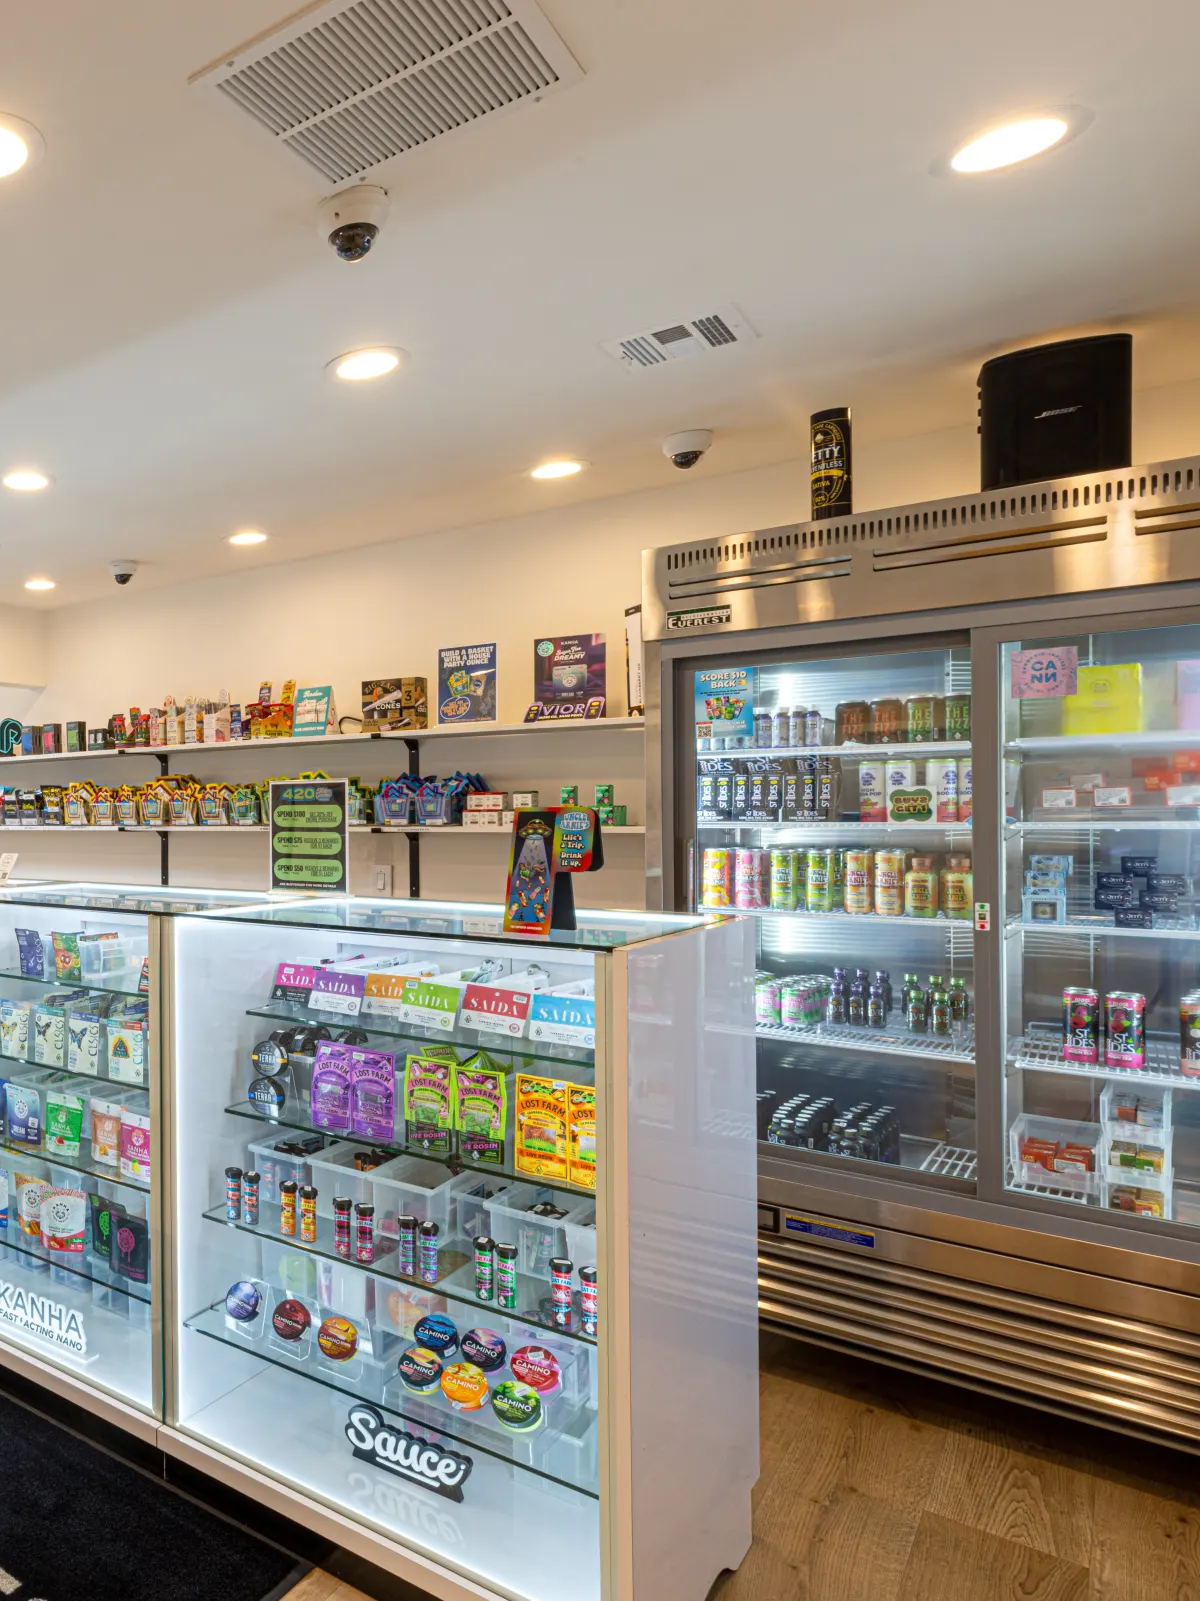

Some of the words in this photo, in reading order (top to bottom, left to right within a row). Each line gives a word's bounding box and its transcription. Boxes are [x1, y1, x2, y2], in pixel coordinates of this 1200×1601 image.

[1034, 405, 1083, 420] BOSE
[812, 444, 841, 462] ETTY
[667, 614, 729, 629] EVEREST
[441, 650, 460, 658] BUILD
[468, 646, 494, 655] BASKET
[444, 655, 460, 663] WITH
[468, 652, 491, 660] HOUSE
[554, 652, 586, 662] DREAMY
[443, 660, 465, 669] PARTY
[466, 658, 489, 666] OUNCE
[1031, 659, 1058, 671] CA
[700, 672, 730, 682] SCORE
[731, 670, 748, 681] $10
[363, 680, 397, 694] ZIG-ZAG
[711, 680, 737, 689] BACK
[404, 690, 413, 702] 3
[375, 701, 401, 711] CONES
[945, 706, 970, 718] THE
[842, 713, 864, 724] THE
[874, 710, 897, 722] THE
[907, 708, 932, 720] THE
[841, 724, 864, 735] FIZZ
[873, 722, 896, 733] FIZZ
[907, 720, 932, 732] FIZZ
[945, 718, 970, 729] FIZZ
[282, 787, 316, 801] 420
[293, 810, 306, 818] $100
[563, 811, 588, 822] UNCLE
[560, 820, 590, 831] ARNIE'S
[567, 841, 585, 850] Trip.
[561, 851, 582, 860] Drink
[569, 860, 582, 868] up.
[317, 980, 357, 995] SAIDA
[371, 984, 404, 998] SAID
[407, 991, 449, 1010] SAIDA
[469, 997, 519, 1017] SAIDA
[538, 1006, 594, 1026] SAIDA
[1075, 1028, 1090, 1039] ST
[1114, 1032, 1128, 1044] ST
[258, 1053, 277, 1063] TERRA
[318, 1061, 333, 1071] LOST
[333, 1061, 351, 1076] FARM
[354, 1069, 371, 1079] LOST
[371, 1070, 392, 1084] FARM
[411, 1078, 427, 1088] LOST
[428, 1079, 449, 1094] FARM
[254, 1091, 272, 1101] TERRA
[461, 1088, 478, 1097] LOST
[479, 1088, 501, 1103] FARM
[520, 1099, 540, 1110] LOST
[541, 1100, 566, 1117] FARM
[572, 1110, 594, 1120] LOST
[423, 1131, 446, 1139] ROSIN
[126, 1143, 149, 1156] KANHA
[473, 1142, 498, 1151] ROSIN
[274, 1313, 293, 1326] CAMINO
[23, 1320, 55, 1340] ACTING
[56, 1333, 84, 1352] NANO
[319, 1333, 341, 1345] CAMINO
[418, 1326, 451, 1342] CAMINO
[465, 1340, 499, 1359] CAMINO
[402, 1360, 436, 1377] CAMINO
[515, 1359, 552, 1377] CAMINO
[445, 1375, 480, 1392] CAMINO
[496, 1394, 533, 1413] CAMINO
[347, 1409, 467, 1487] Sauce
